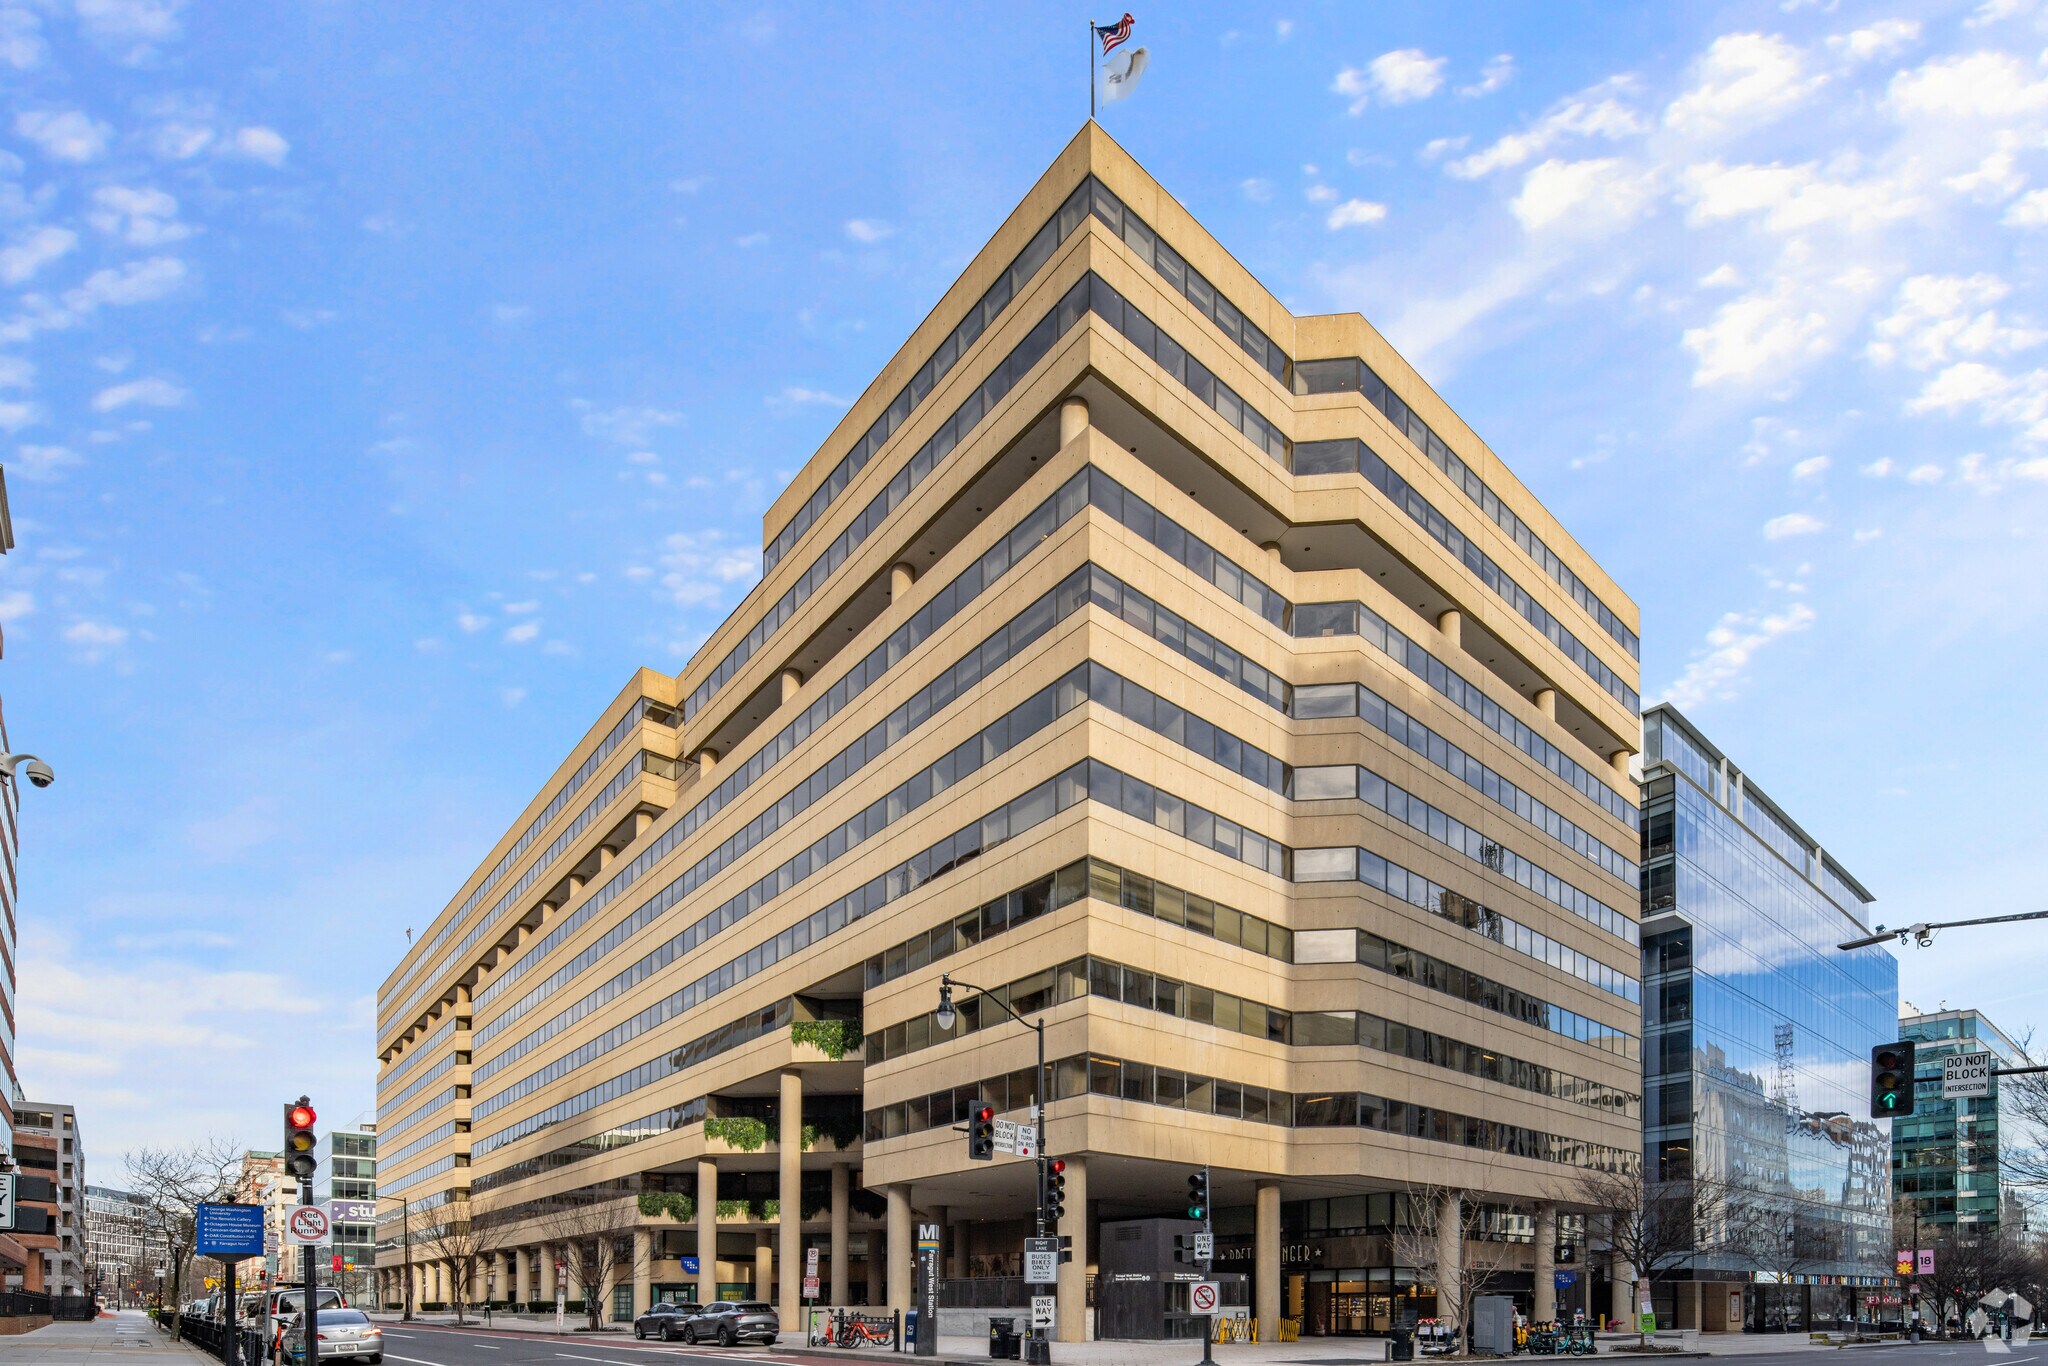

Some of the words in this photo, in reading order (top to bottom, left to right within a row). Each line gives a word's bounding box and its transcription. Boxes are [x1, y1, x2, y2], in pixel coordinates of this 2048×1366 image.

[1947, 1057, 1962, 1068] DO
[1966, 1055, 1987, 1066] NOT
[1947, 1067, 1986, 1080] BLOCK
[1946, 1083, 1986, 1092] INTERSECTION
[996, 1120, 1004, 1129] DO
[1005, 1122, 1015, 1130] NOT
[995, 1130, 1013, 1140] BLOCK
[300, 1211, 318, 1219] Red
[298, 1219, 321, 1227] Light
[291, 1227, 328, 1236] Running
[920, 1224, 936, 1240] M
[1282, 1245, 1310, 1262] NGER
[1561, 1249, 1569, 1260] P
[927, 1249, 936, 1277] Farragut
[1920, 1256, 1931, 1265] 18
[927, 1295, 935, 1318] Station
[1035, 1307, 1052, 1315] WAY
